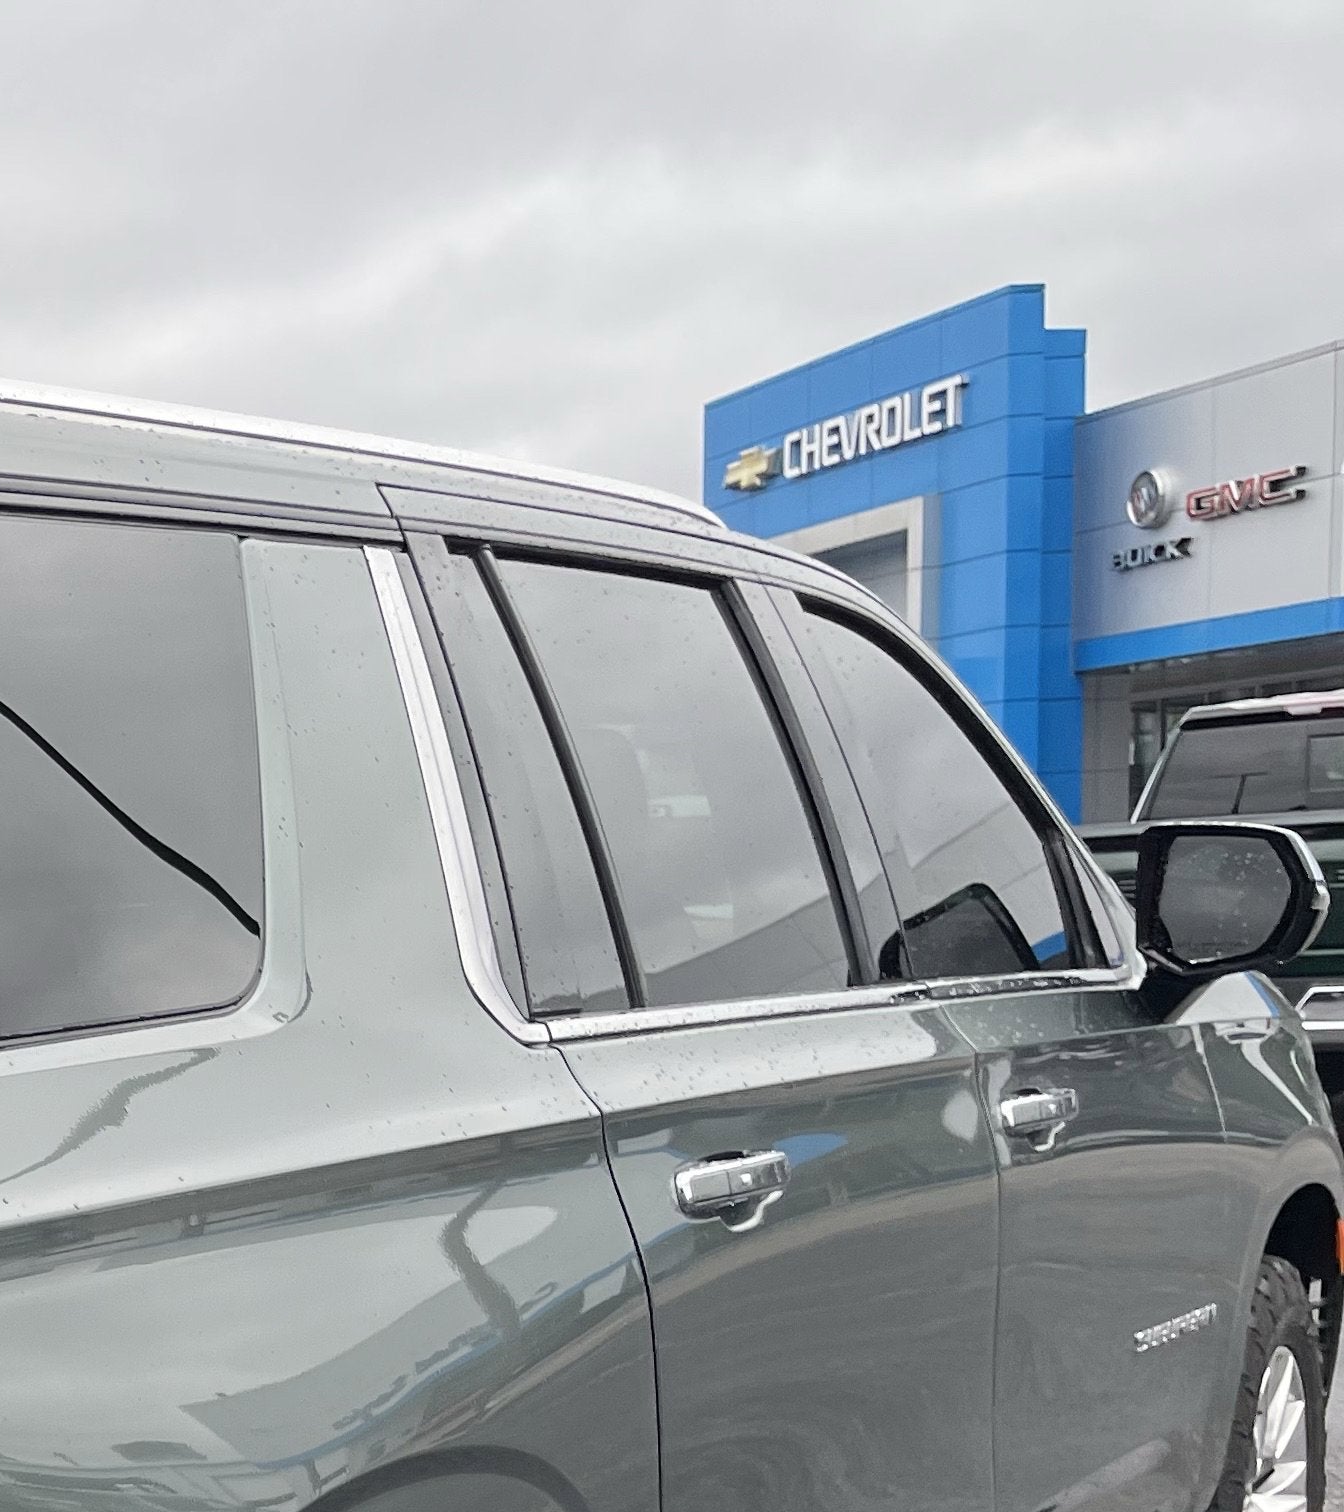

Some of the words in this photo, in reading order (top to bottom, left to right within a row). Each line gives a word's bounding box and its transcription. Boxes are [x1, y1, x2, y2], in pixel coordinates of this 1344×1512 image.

[782, 374, 967, 479] CHEVROLET
[1186, 466, 1306, 521] GMC
[1111, 537, 1193, 571] BUICK
